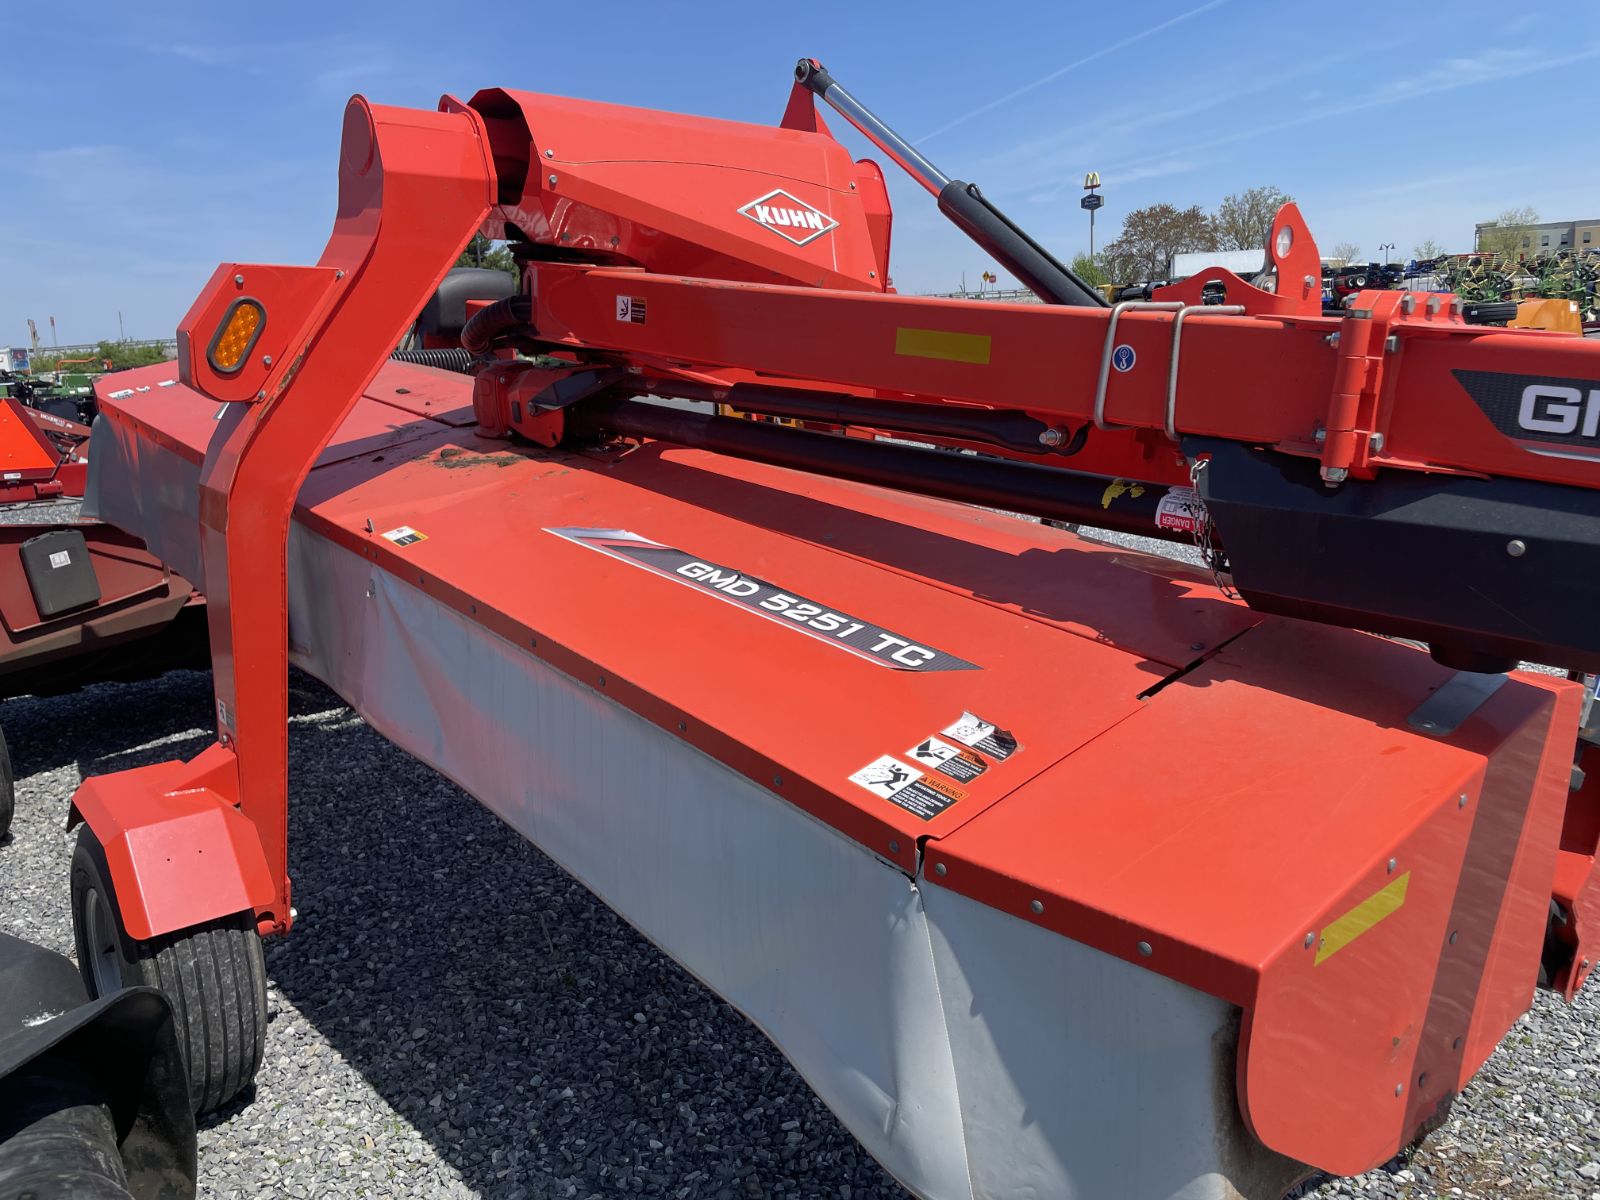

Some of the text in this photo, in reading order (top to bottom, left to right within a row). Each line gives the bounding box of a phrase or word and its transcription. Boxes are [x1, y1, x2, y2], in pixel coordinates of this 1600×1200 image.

[754, 204, 825, 230] KUHN
[1518, 384, 1600, 437] G
[1162, 515, 1190, 528] DANGER
[676, 561, 936, 668] GMD 5251 TC
[929, 779, 963, 799] WARNING
